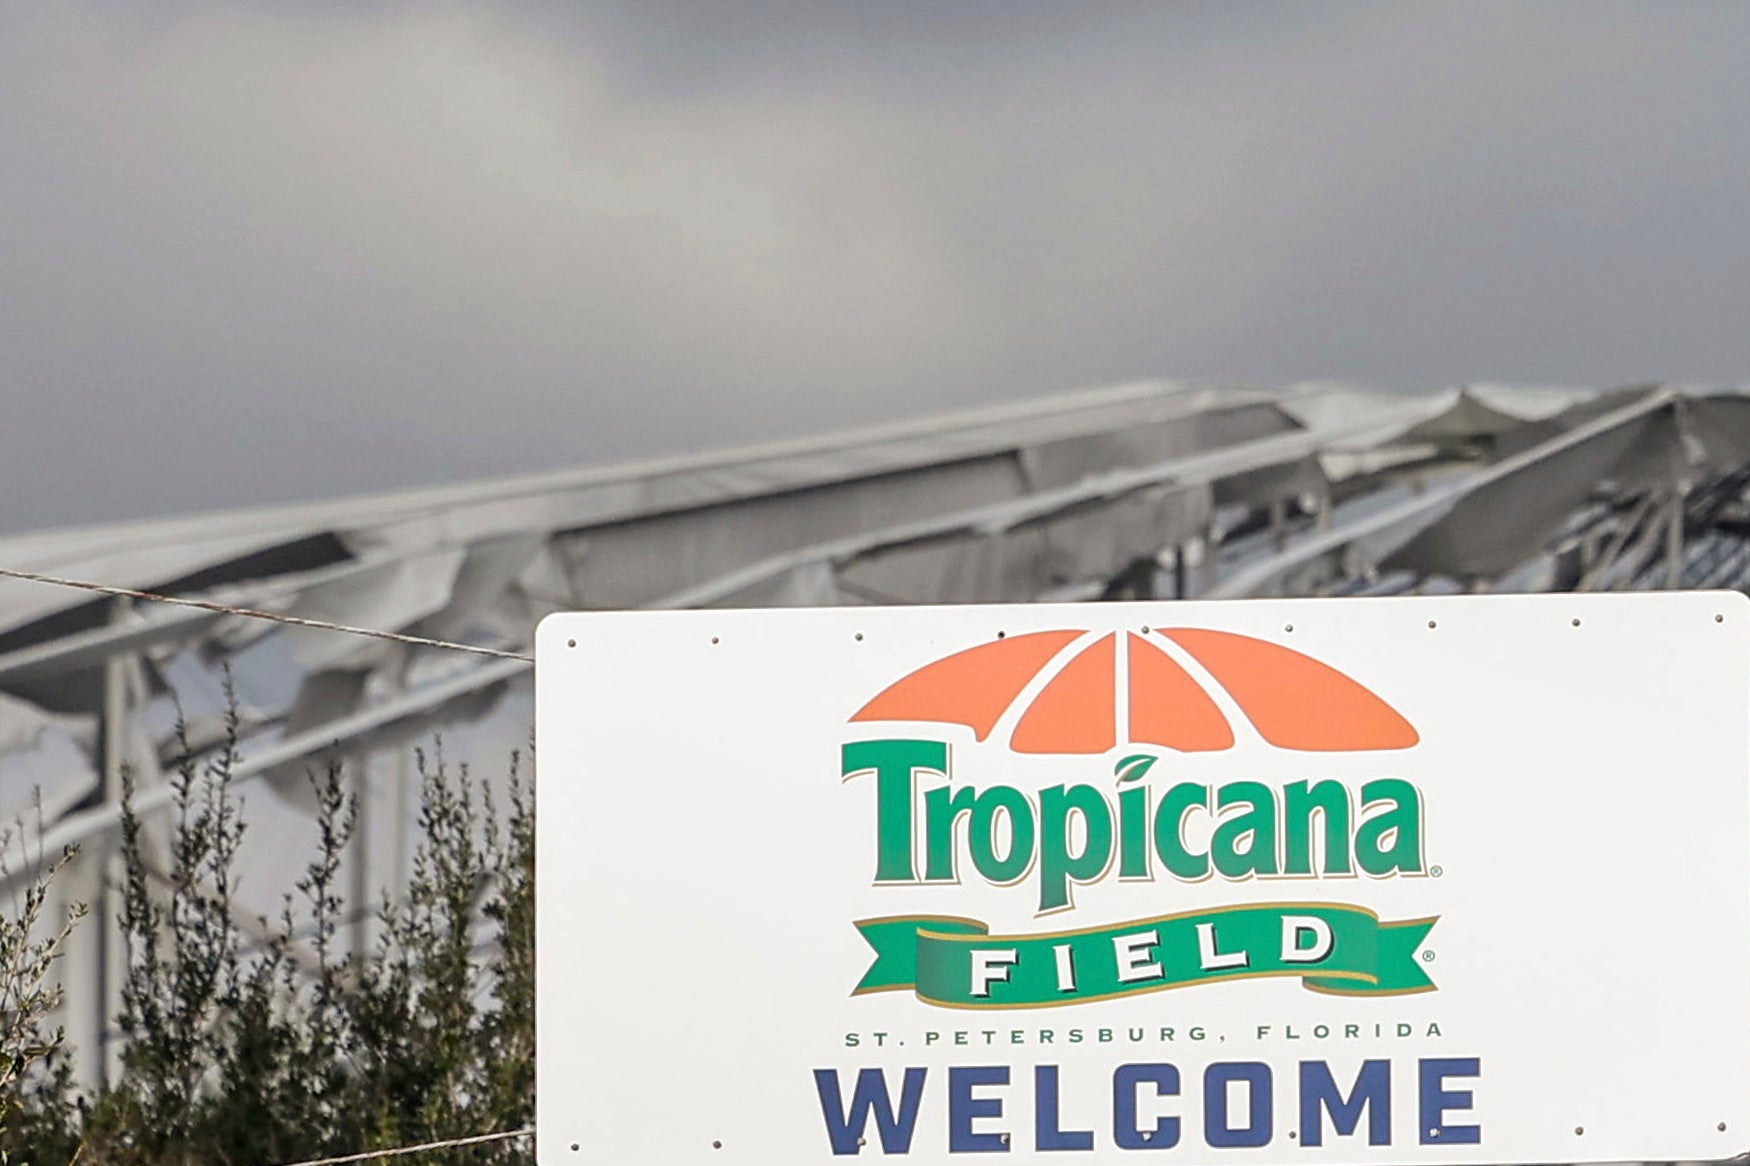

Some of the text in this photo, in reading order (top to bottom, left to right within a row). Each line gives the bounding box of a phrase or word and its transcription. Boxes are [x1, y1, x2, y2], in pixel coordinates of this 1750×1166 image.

[841, 738, 1430, 918] Tropicana
[969, 915, 1335, 998] FIELD
[844, 1022, 1443, 1047] ST. PETERSBURG, FLORIDA
[812, 1056, 1482, 1156] WELCOME
